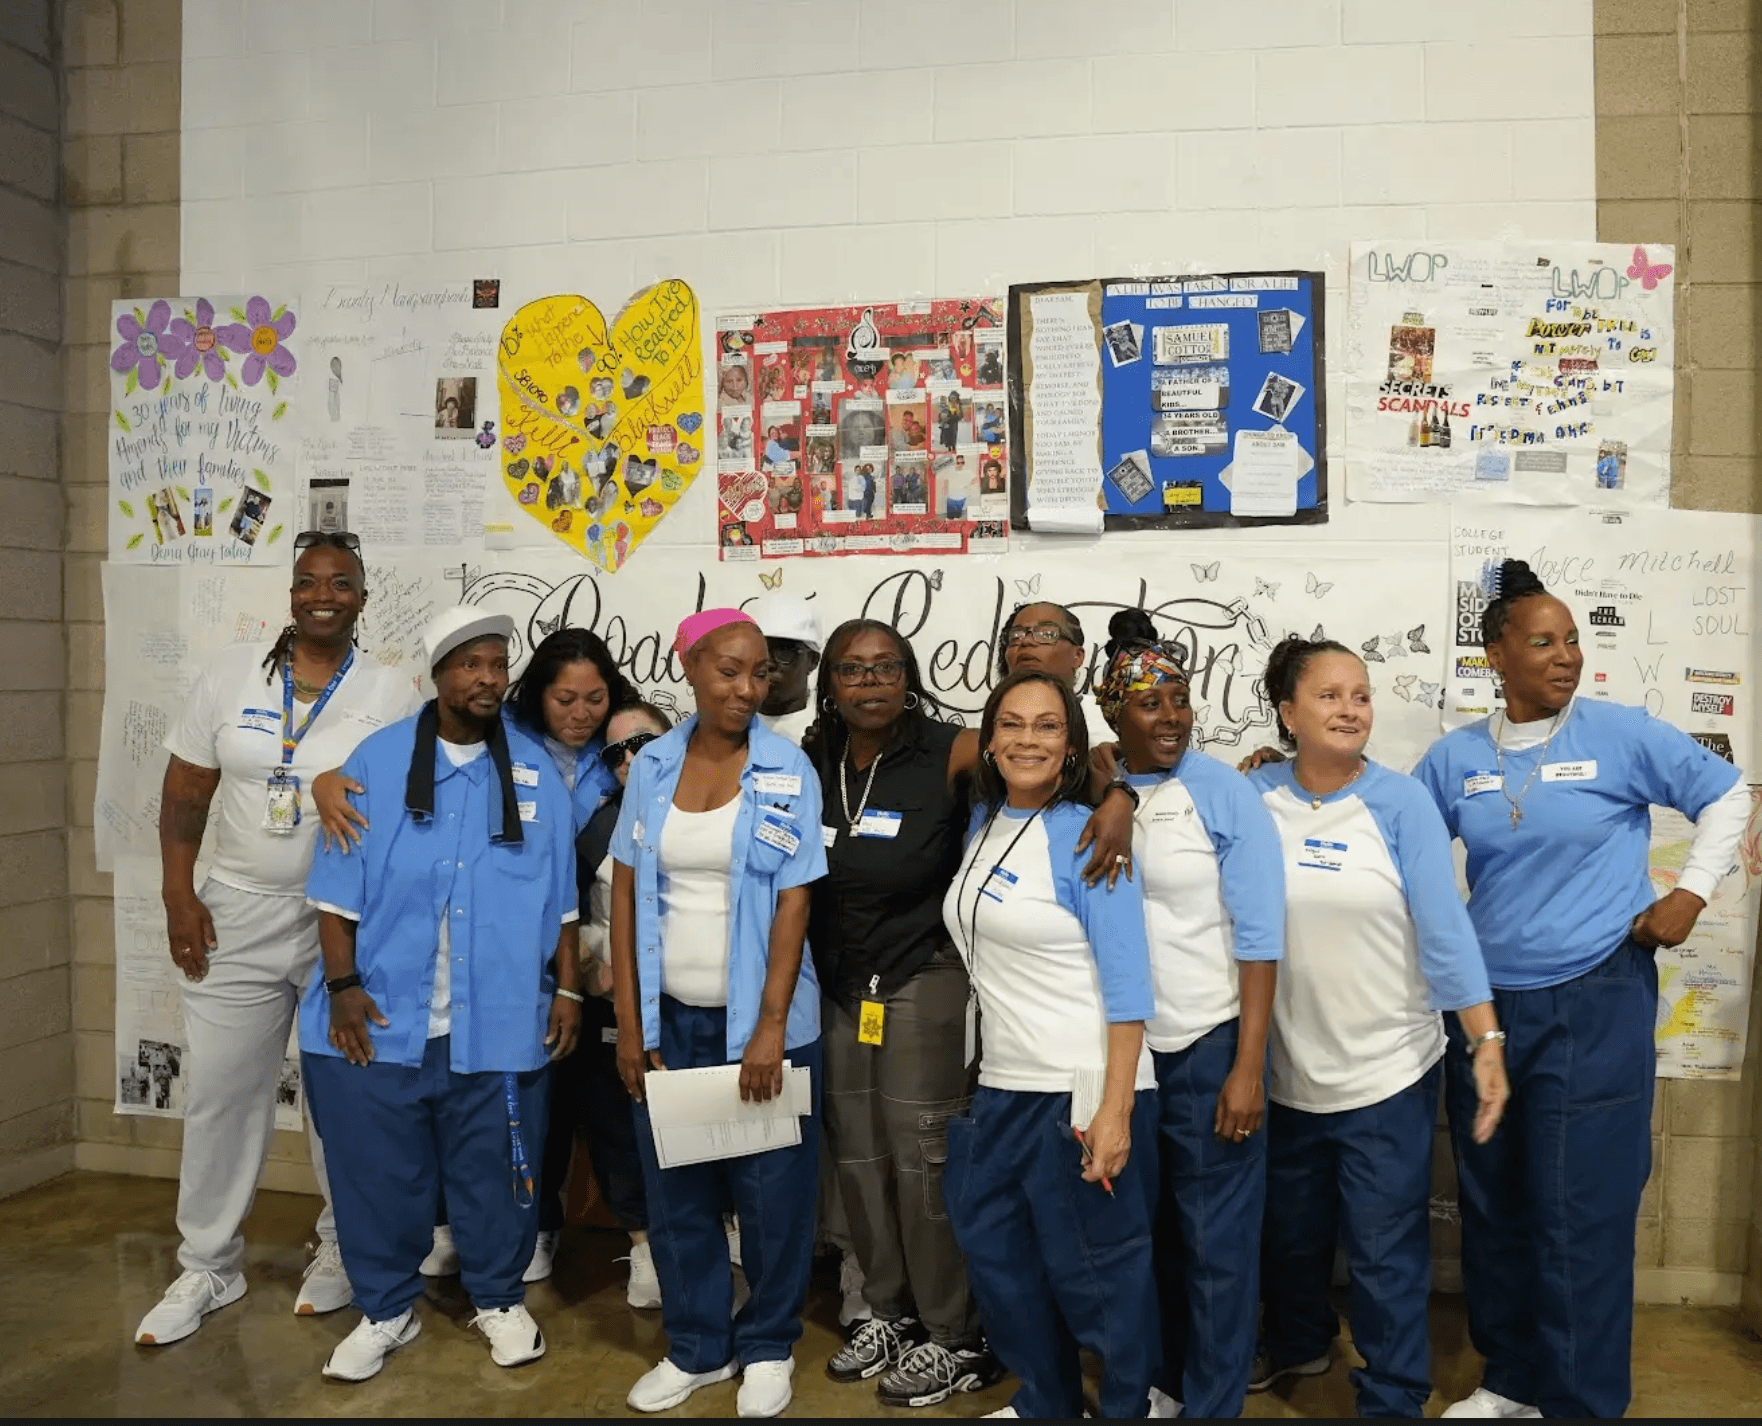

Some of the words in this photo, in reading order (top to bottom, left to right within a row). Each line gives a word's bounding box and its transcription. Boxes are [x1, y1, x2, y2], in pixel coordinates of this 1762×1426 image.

[1369, 251, 1447, 282] LWOP
[1152, 284, 1181, 295] WAS
[1185, 280, 1227, 292] TAKEN
[1231, 279, 1254, 291] FOR
[1260, 278, 1270, 290] A
[1552, 266, 1630, 299] LWOP
[1149, 297, 1165, 308] TO
[619, 313, 655, 352] How
[634, 296, 692, 363] Reacted
[1166, 332, 1213, 344] SAMUEL
[652, 350, 669, 367] To
[668, 326, 686, 352] It
[1380, 381, 1454, 398] SECRETS
[132, 403, 149, 427] 30
[154, 391, 190, 433] years
[194, 382, 209, 413] of
[1377, 397, 1471, 417] SCANDALS
[172, 415, 191, 447] for
[199, 421, 219, 450] my
[120, 459, 147, 490] and
[1455, 527, 1506, 540] COLLEGE
[1455, 545, 1509, 556] STUDENT
[1530, 545, 1594, 587] Joyce
[1618, 550, 1735, 574] Mitchell
[1575, 589, 1598, 597] Didn't
[1599, 591, 1618, 599] Have
[1629, 592, 1643, 600] Die
[1693, 586, 1746, 606] LOST
[1459, 598, 1489, 613] SID
[1693, 615, 1748, 636] SOUL
[1461, 656, 1489, 667] MAKI
[1457, 667, 1497, 678] COMEB
[1694, 693, 1732, 705] DESTROY
[1692, 704, 1725, 714] MYSELF
[1698, 736, 1725, 753] The
